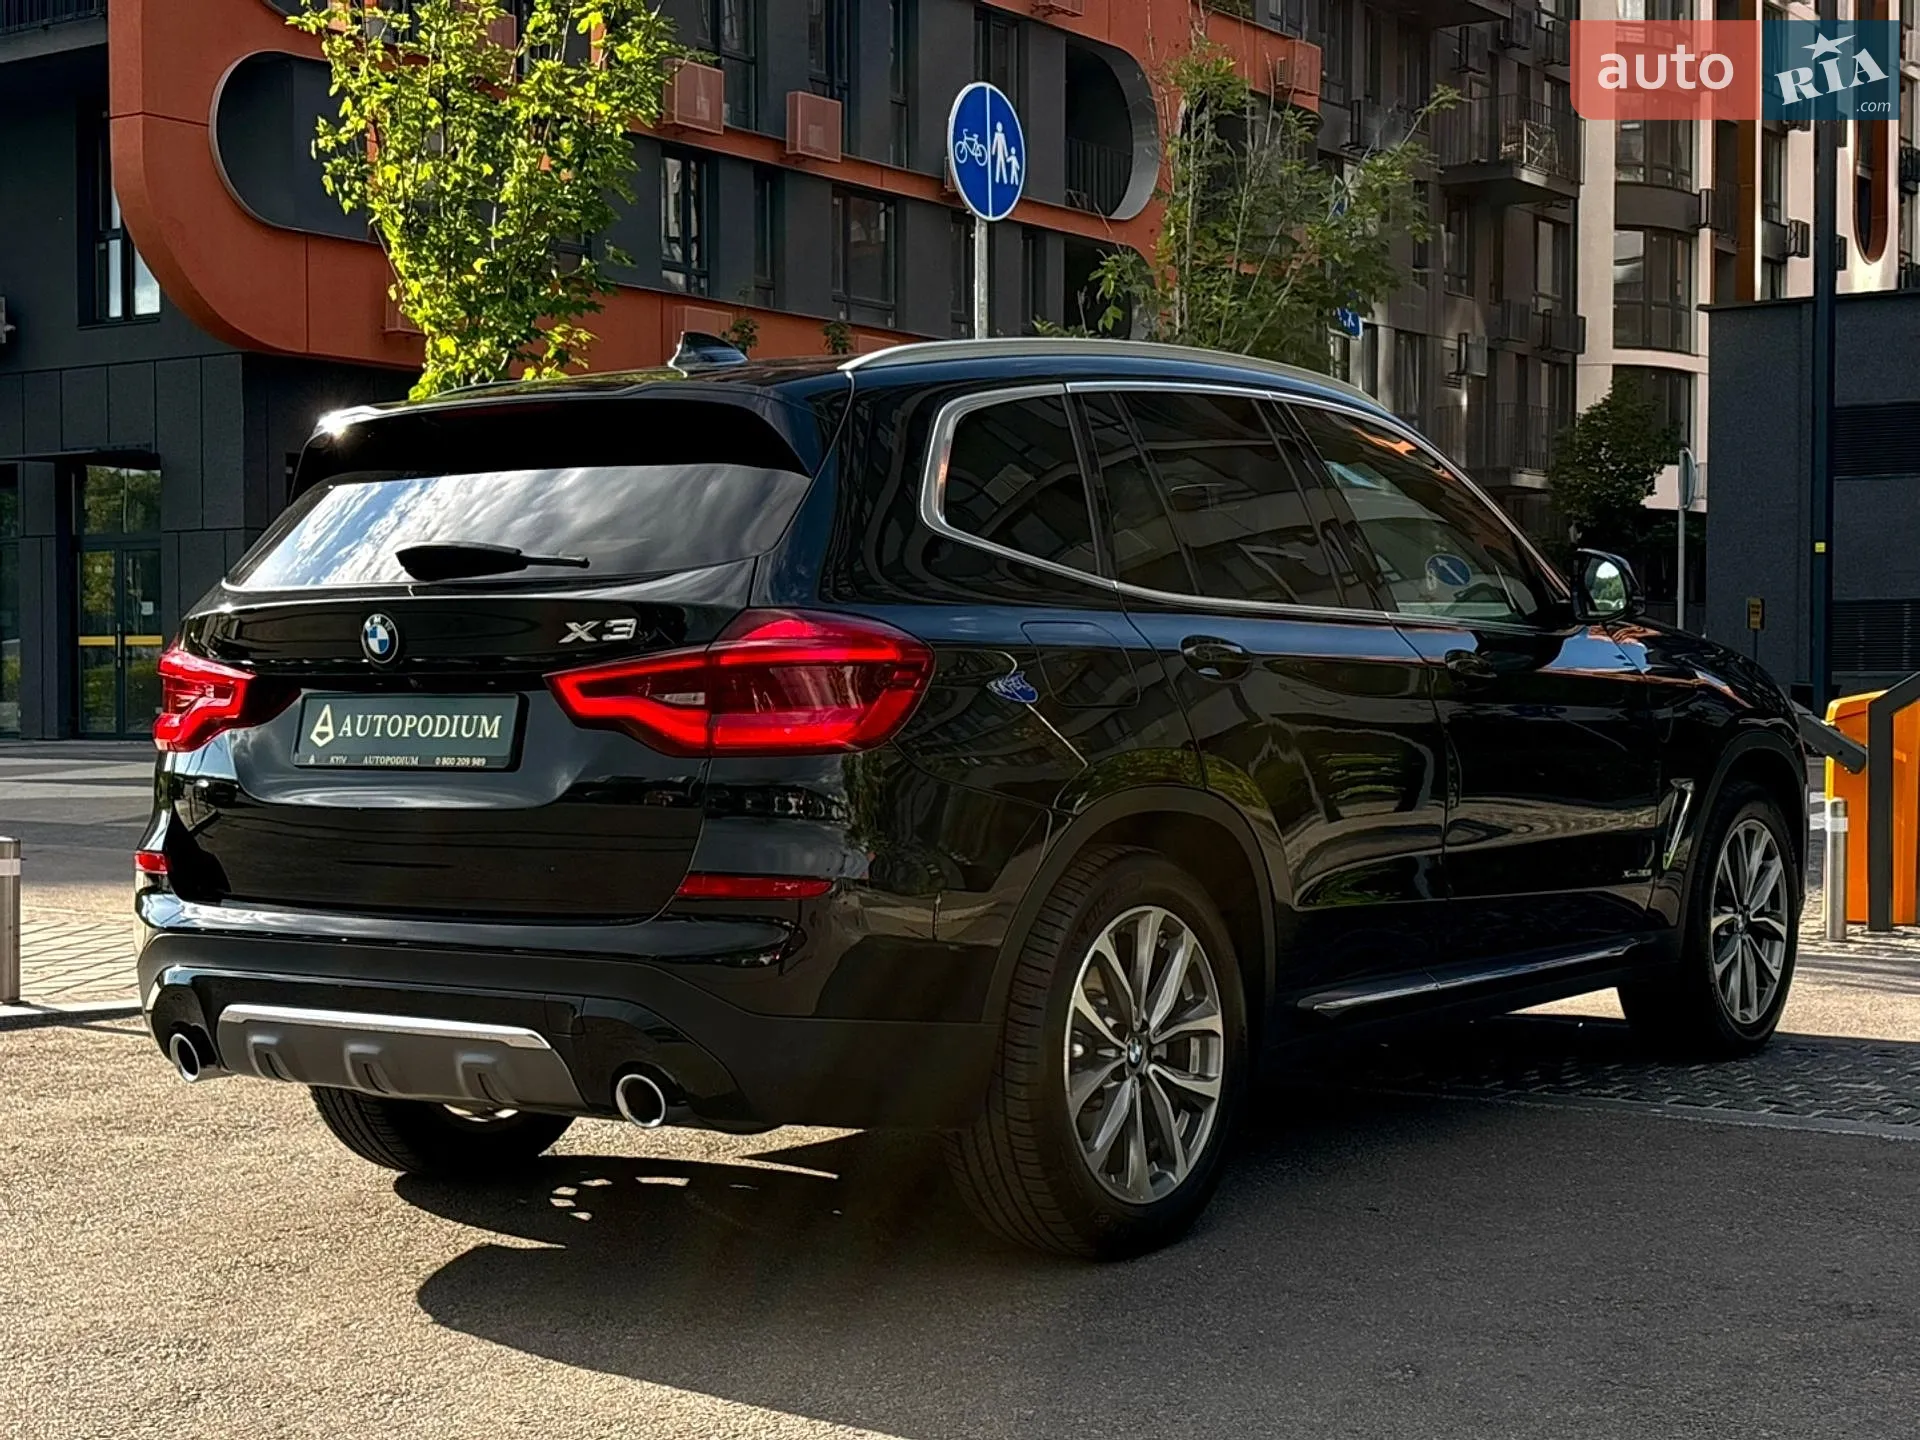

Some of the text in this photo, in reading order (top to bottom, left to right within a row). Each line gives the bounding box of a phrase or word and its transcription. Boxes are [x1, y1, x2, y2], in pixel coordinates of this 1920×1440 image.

[558, 618, 637, 643] X3
[338, 714, 502, 739] AUTOPODIUM
[362, 755, 419, 766] AUTOPODIUM
[435, 756, 441, 766] 0
